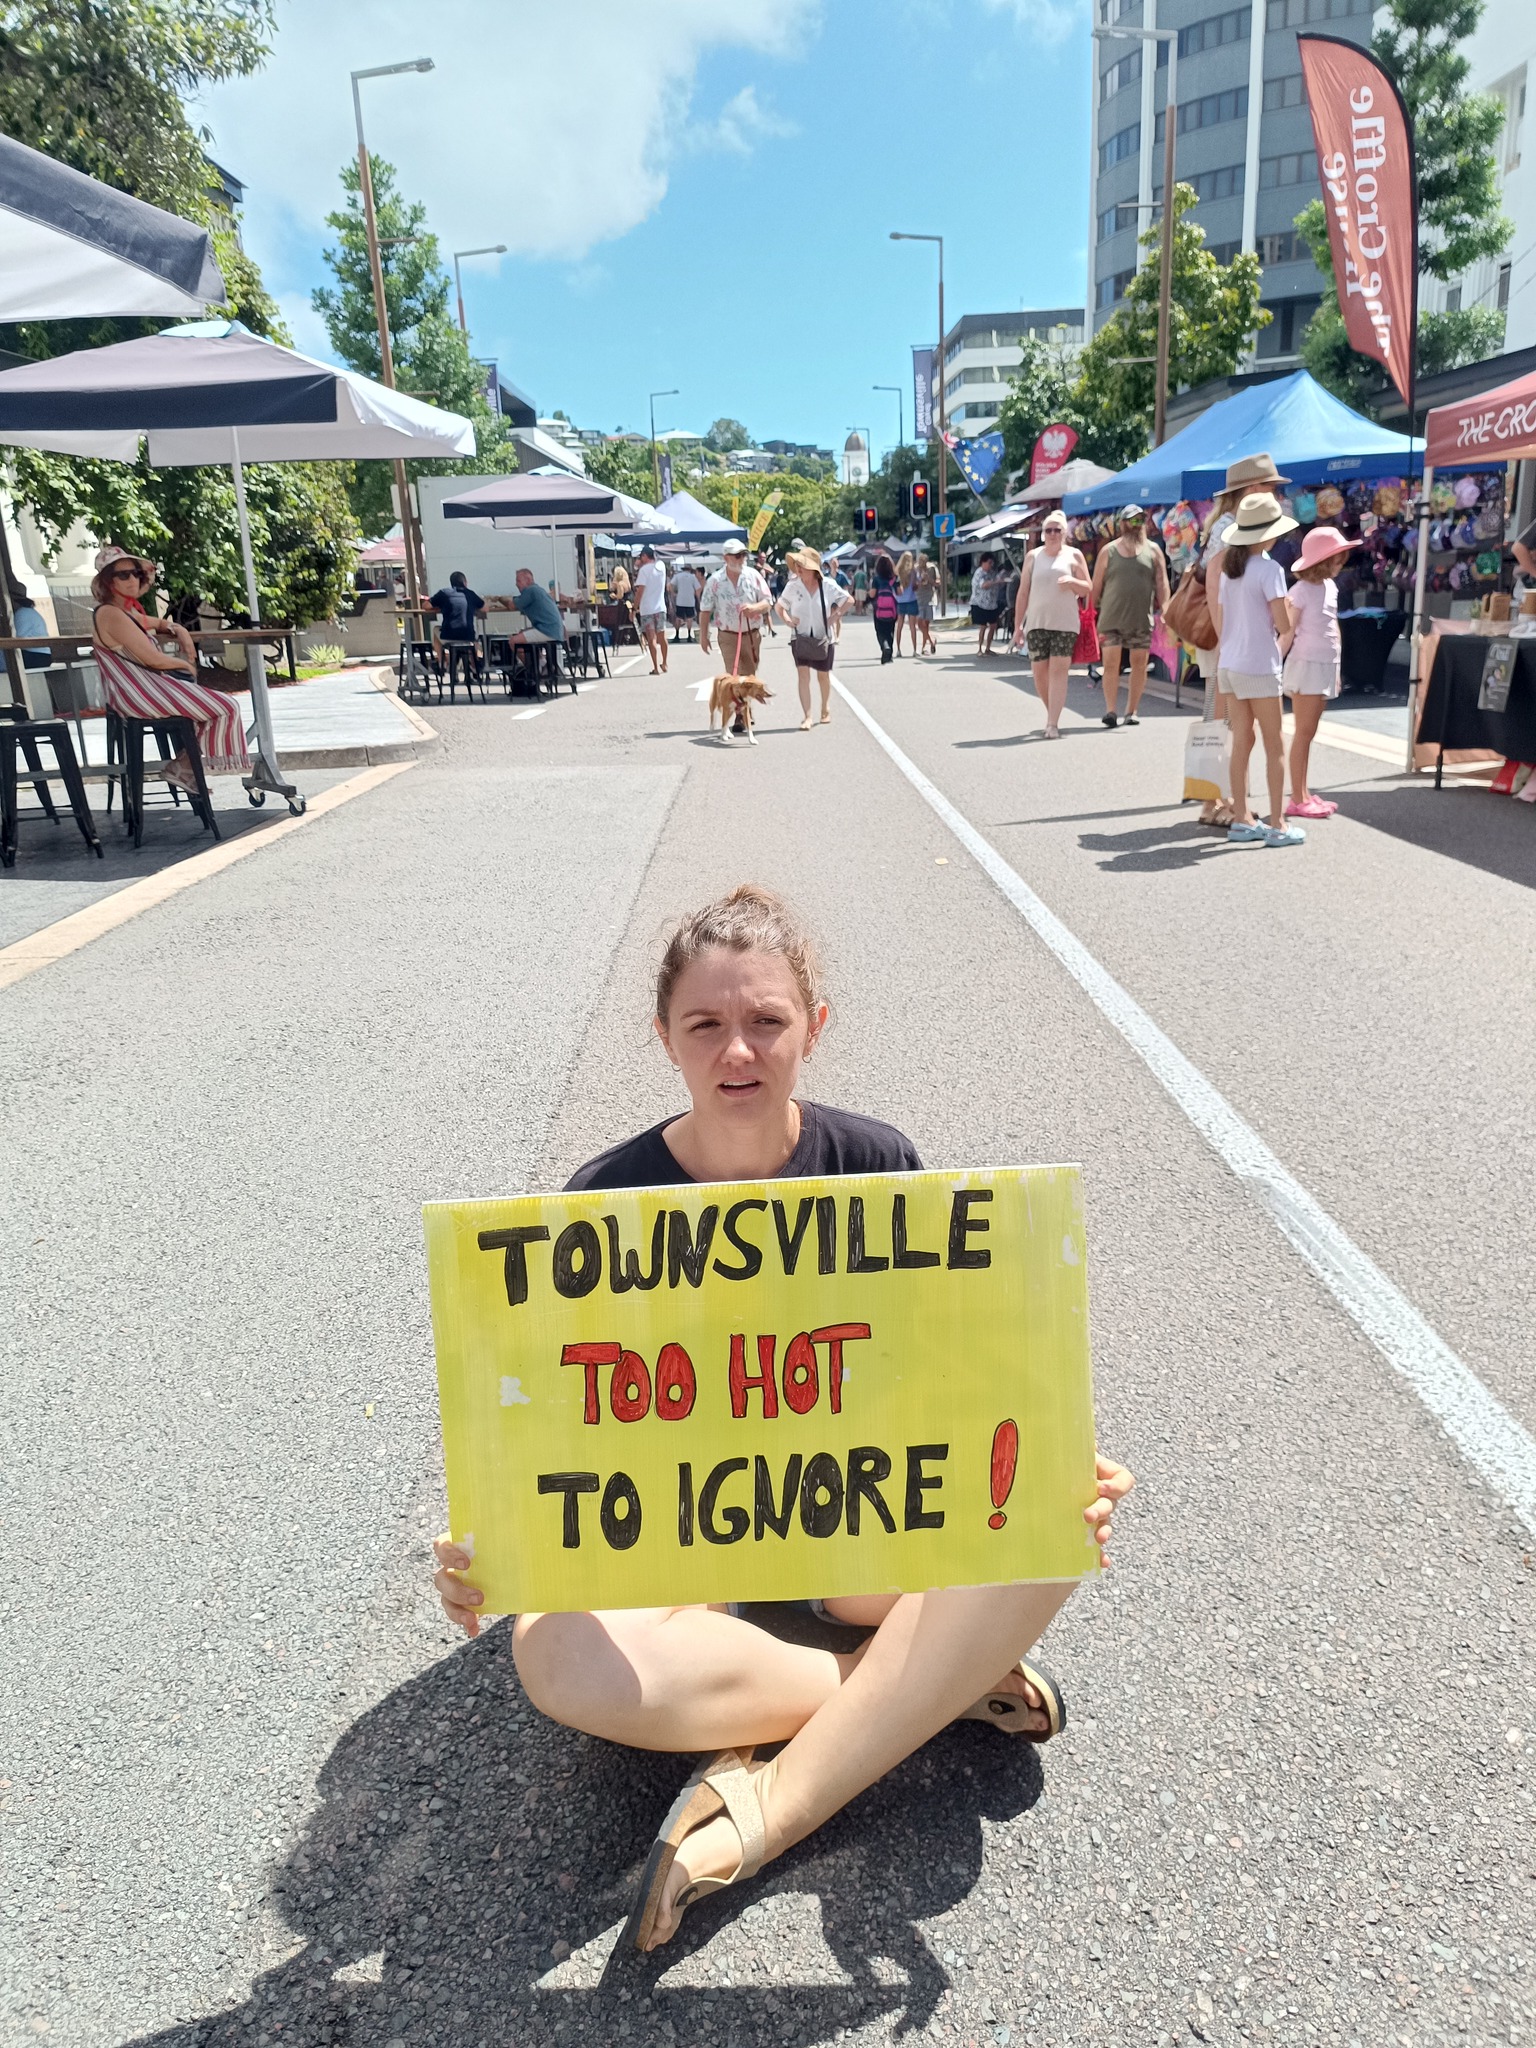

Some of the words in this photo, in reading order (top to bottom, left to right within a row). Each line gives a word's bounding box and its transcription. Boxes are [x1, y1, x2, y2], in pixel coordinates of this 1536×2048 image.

[1456, 411, 1495, 448] THE
[751, 511, 769, 548] JUICE
[478, 1189, 994, 1306] TOWNSVILLE
[560, 1341, 697, 1425] TOO
[728, 1322, 871, 1419] HOT
[537, 1471, 642, 1550] TO
[677, 1443, 949, 1548] IGNORE
[987, 1417, 1019, 1530] !
